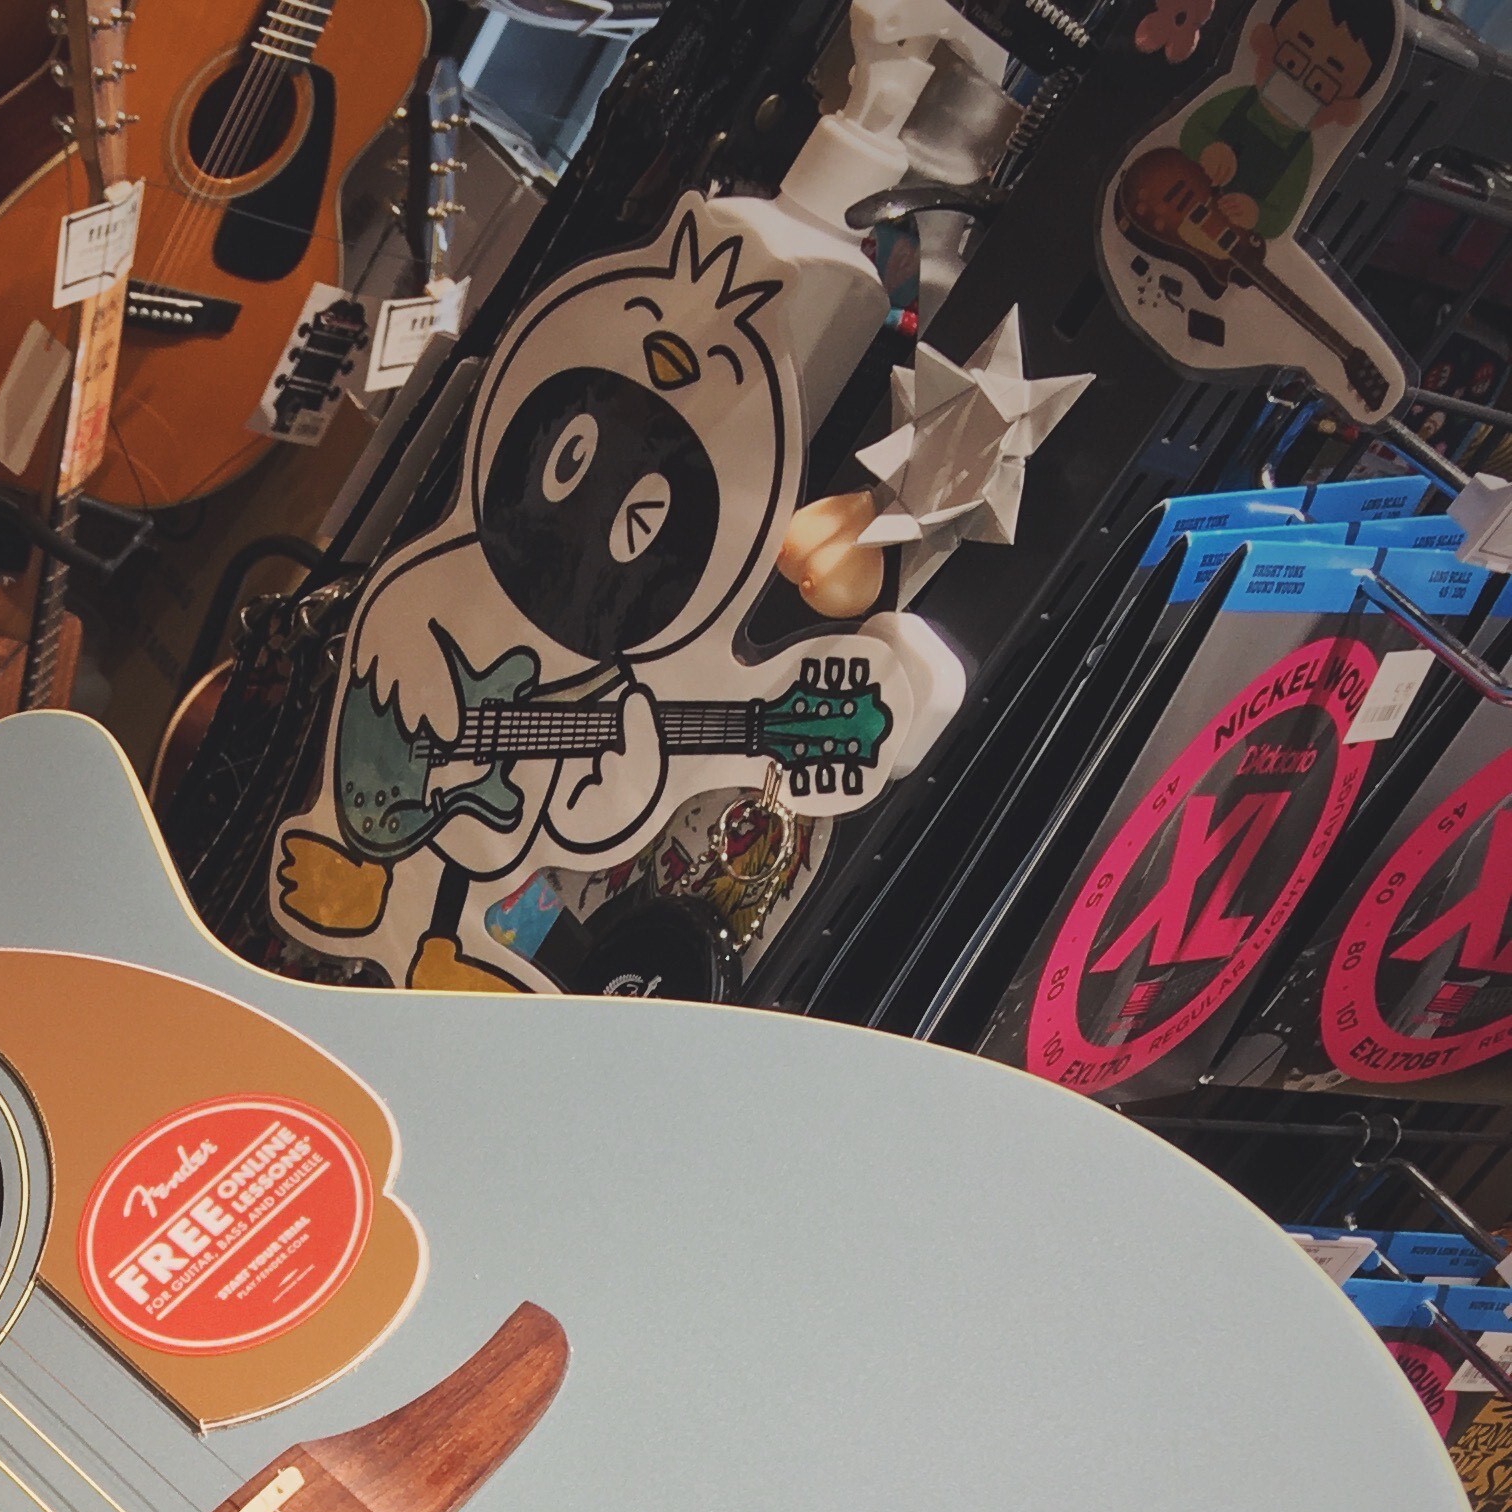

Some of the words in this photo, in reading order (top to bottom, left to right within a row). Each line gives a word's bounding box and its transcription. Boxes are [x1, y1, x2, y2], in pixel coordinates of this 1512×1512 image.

[1213, 658, 1320, 752] NICKEL
[1151, 775, 1181, 814] 45
[1437, 800, 1468, 833] 45
[1085, 872, 1114, 908] 65
[1375, 871, 1407, 906] 60
[1148, 959, 1246, 1053] REGULAR
[1253, 877, 1306, 951] LIGHT
[1312, 767, 1358, 859] GAUGE
[1342, 940, 1366, 971] 80
[1046, 965, 1069, 1002] 80
[1335, 1000, 1359, 1032] 107
[1058, 1053, 1133, 1086] EXL170
[1349, 1035, 1462, 1071] EXL170BT
[123, 1138, 218, 1218] Fender
[217, 1126, 297, 1200] ONLINE
[114, 1196, 235, 1306] FREE
[146, 1290, 172, 1315] FOR
[171, 1251, 219, 1293] GUITAR,
[216, 1220, 248, 1251] BASS
[248, 1195, 276, 1224] AND
[274, 1152, 324, 1198] UKULELE
